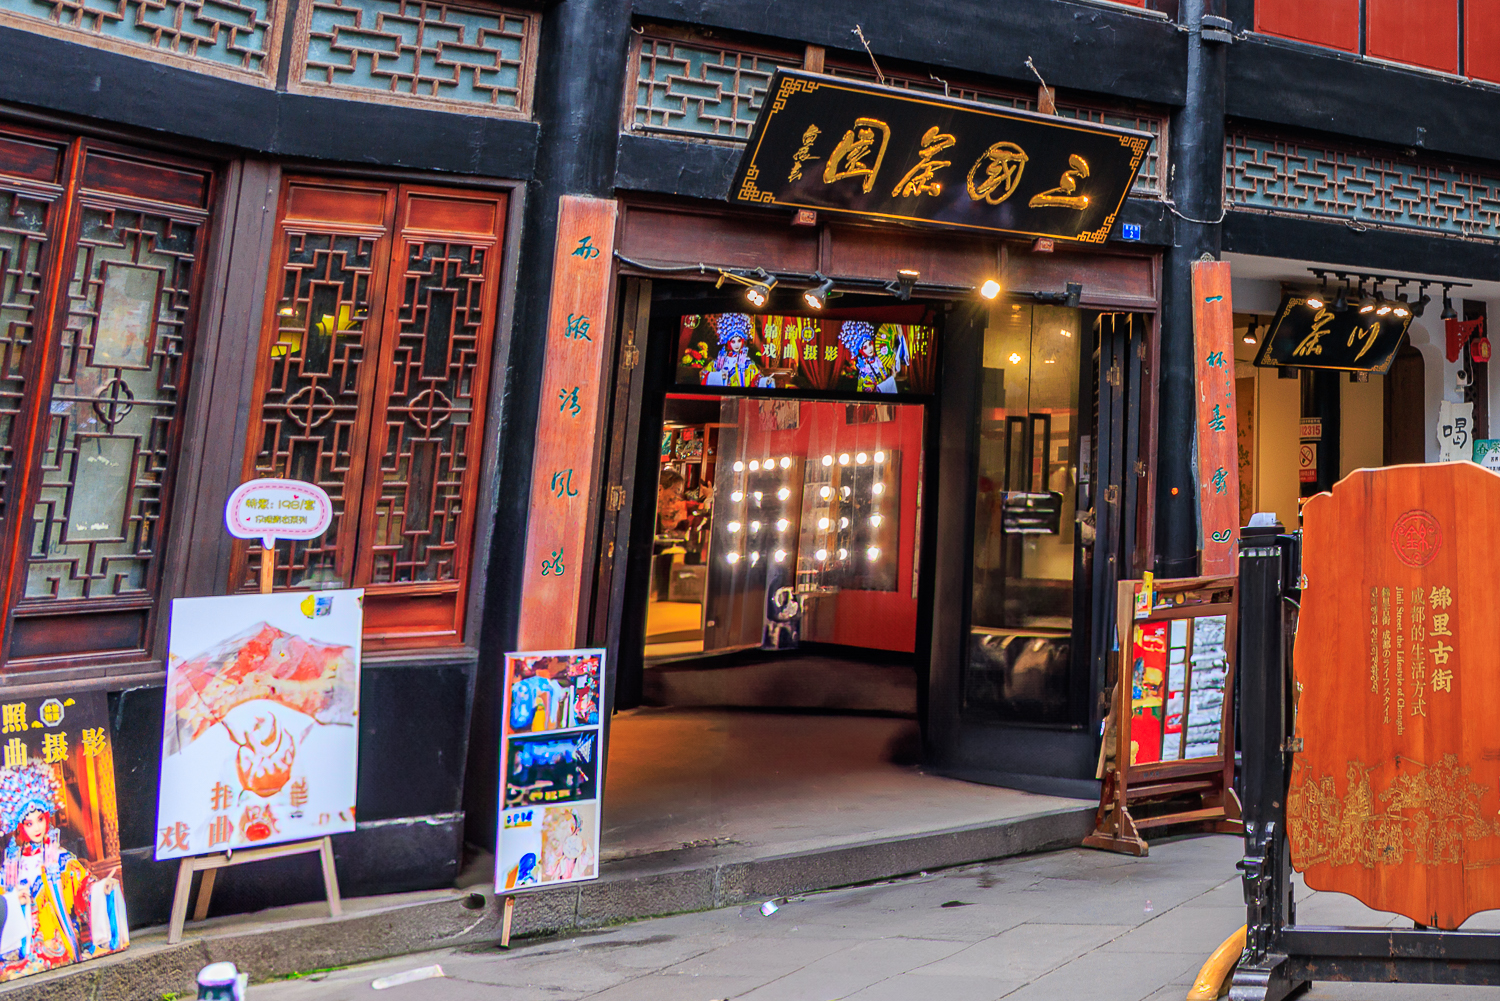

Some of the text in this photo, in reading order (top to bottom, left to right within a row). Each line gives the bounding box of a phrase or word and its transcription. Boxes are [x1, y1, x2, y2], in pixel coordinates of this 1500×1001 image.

[762, 343, 839, 362] 戏曲摄影
[1443, 417, 1467, 449] 喝
[1396, 586, 1404, 605] Jinli
[1396, 635, 1405, 649] the
[1410, 587, 1427, 717] 成都的生活方式
[1428, 585, 1454, 693] 锦里古街
[1395, 650, 1405, 687] Lifestyle
[1396, 687, 1405, 697] of
[1395, 698, 1406, 736] Chengdu
